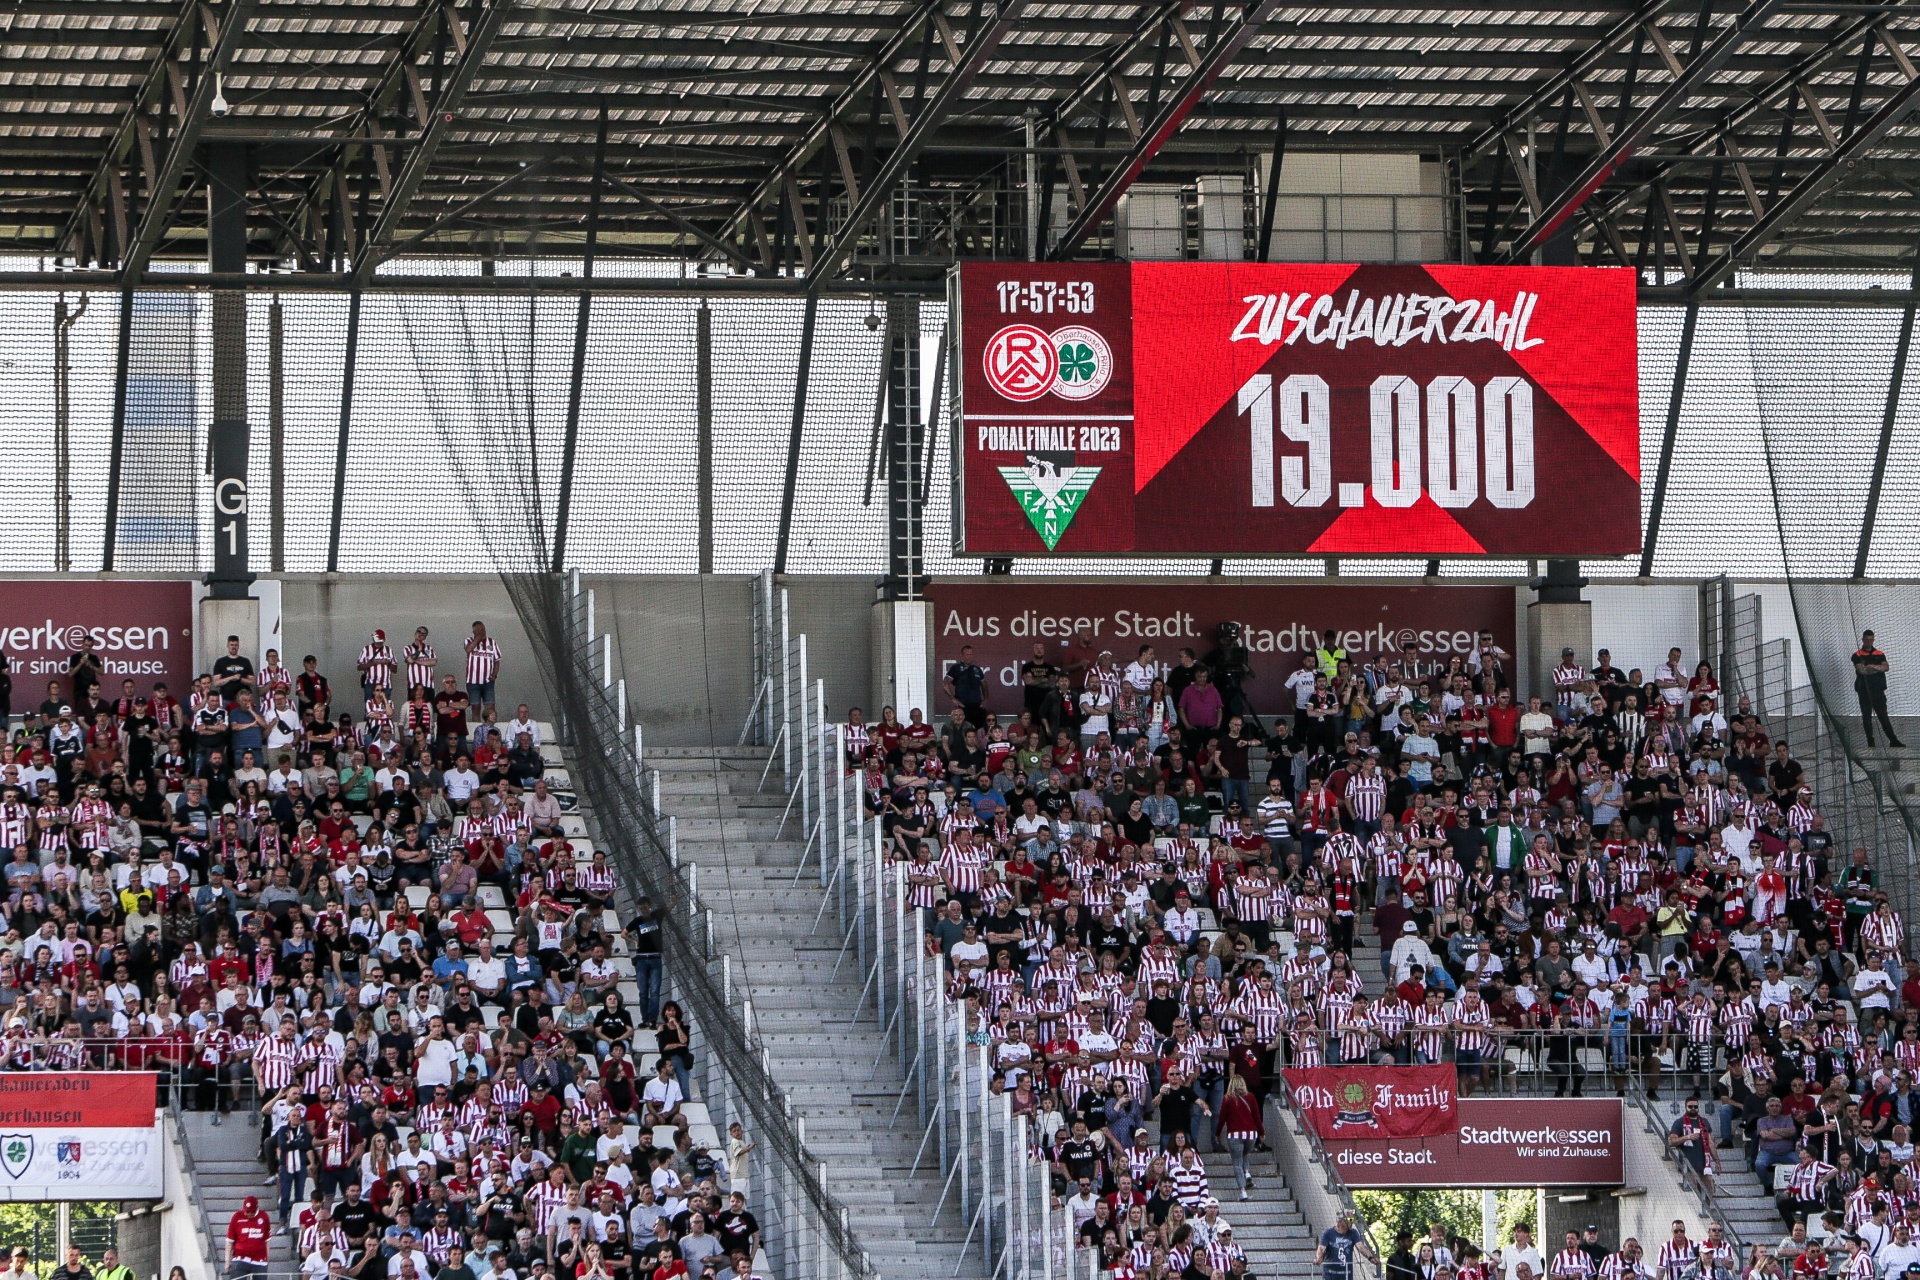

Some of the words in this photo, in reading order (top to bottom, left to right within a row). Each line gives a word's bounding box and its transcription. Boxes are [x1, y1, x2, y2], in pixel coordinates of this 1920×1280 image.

[997, 281, 1094, 313] 17:57:53
[1230, 289, 1544, 352] ZUSCHAUERZAHL
[978, 426, 1076, 451] POKALFINALE
[1079, 426, 1121, 451] 2023
[1237, 374, 1535, 509] 19.000
[215, 478, 247, 515] G
[222, 520, 236, 555] 1
[943, 610, 1000, 637] Aus
[1010, 609, 1105, 637] dieser
[1114, 609, 1202, 637] Stadt.
[8, 657, 25, 674] ir
[100, 656, 168, 675] hause.
[1294, 1085, 1334, 1110] Old
[1373, 1084, 1450, 1116] Family
[1337, 1149, 1383, 1164] diese
[1388, 1148, 1437, 1164] Stadt.
[1516, 1146, 1536, 1157] Wir
[1537, 1146, 1560, 1157] sind
[1563, 1146, 1611, 1157] Zuhause.
